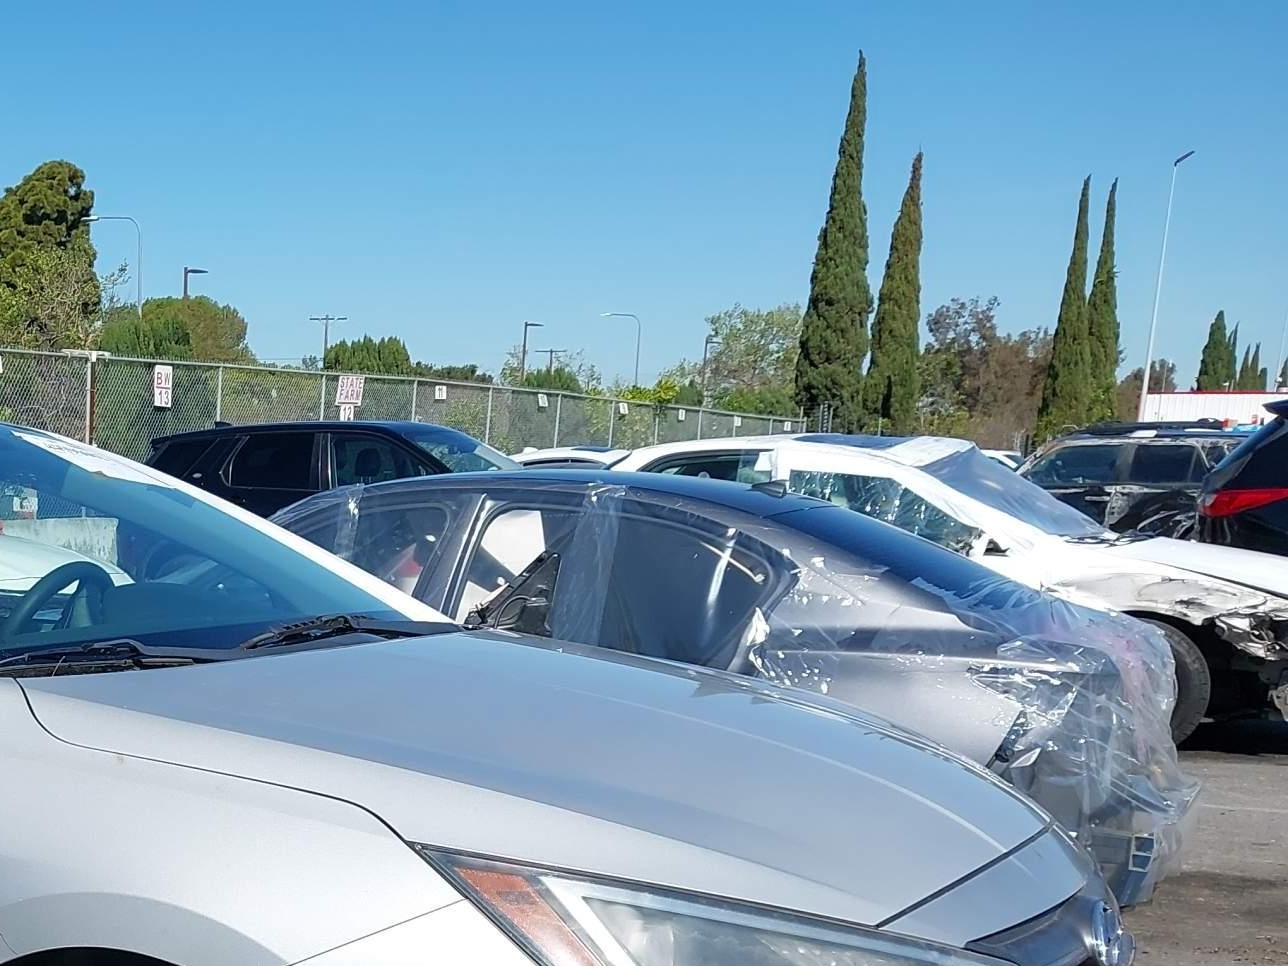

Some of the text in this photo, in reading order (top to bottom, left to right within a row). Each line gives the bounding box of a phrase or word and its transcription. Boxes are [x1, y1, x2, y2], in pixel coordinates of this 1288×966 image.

[340, 376, 363, 389] STATE
[158, 390, 170, 405] 13
[338, 388, 361, 401] FARM
[342, 406, 353, 421] 12
